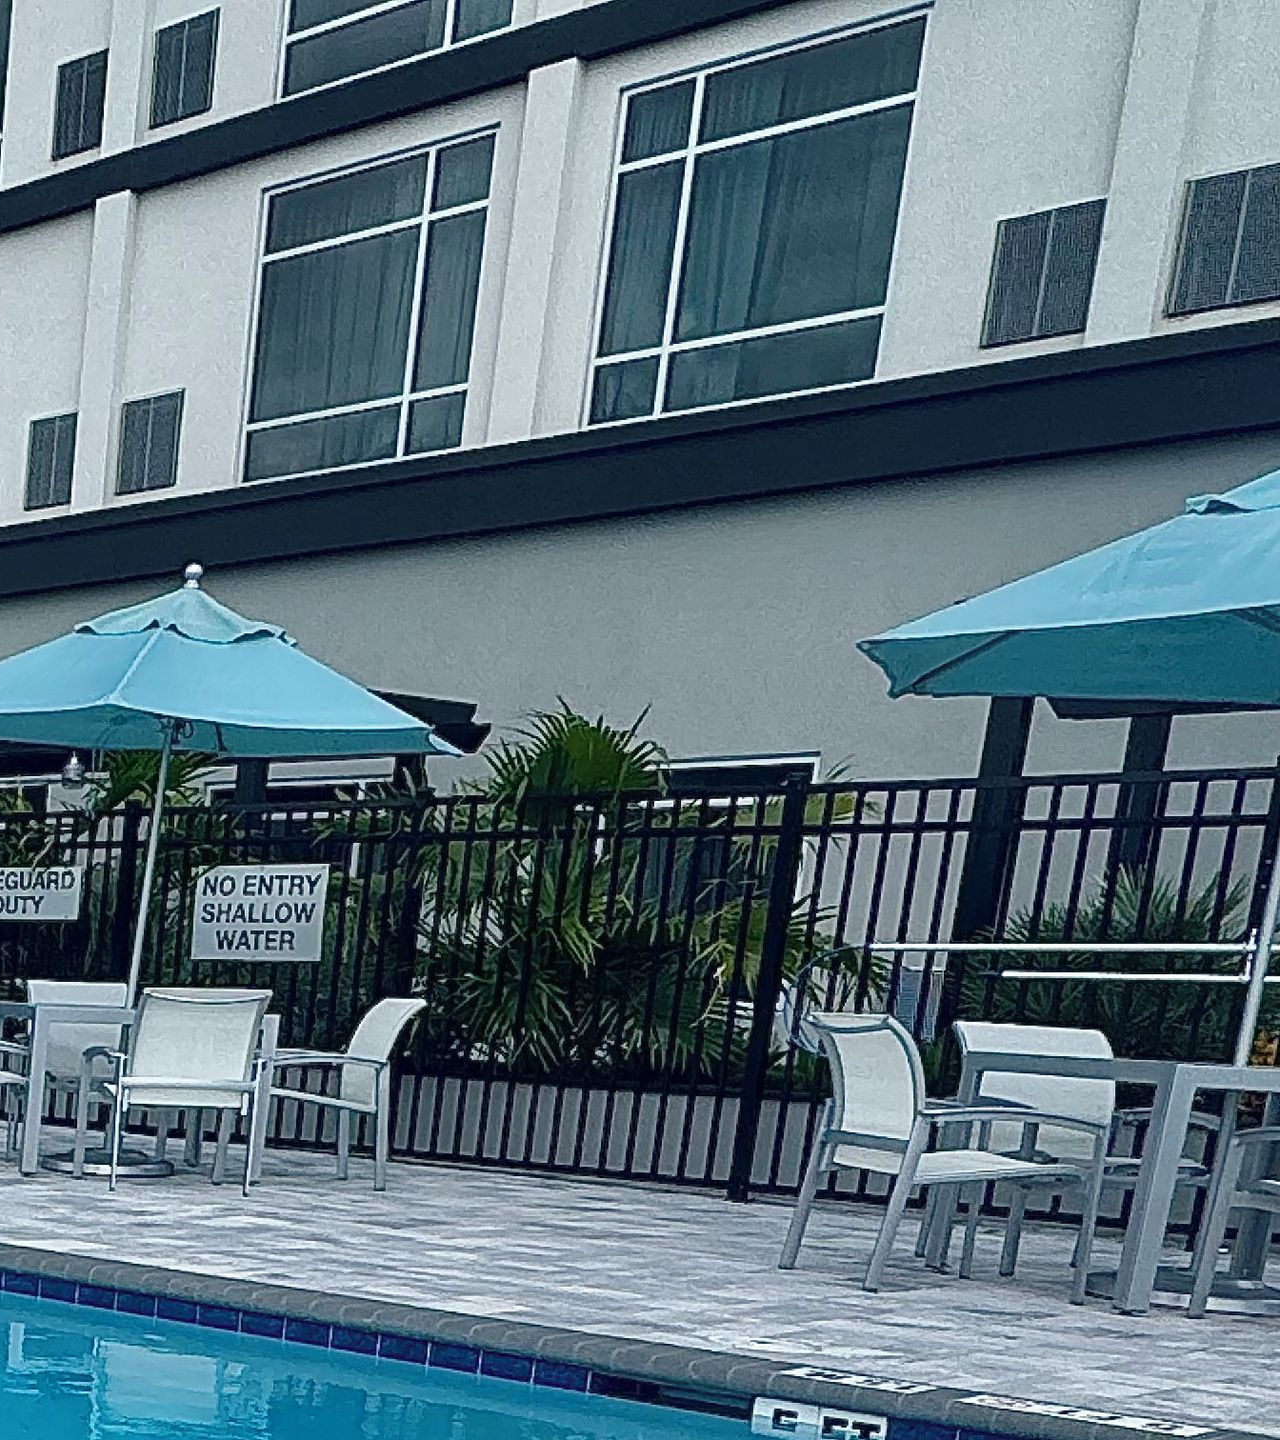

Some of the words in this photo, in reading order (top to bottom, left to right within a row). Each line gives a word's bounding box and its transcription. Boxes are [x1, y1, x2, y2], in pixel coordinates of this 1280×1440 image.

[202, 874, 236, 897] NO
[242, 873, 322, 896] ENTRY
[200, 902, 316, 924] SHALLOW
[215, 930, 295, 951] WATER
